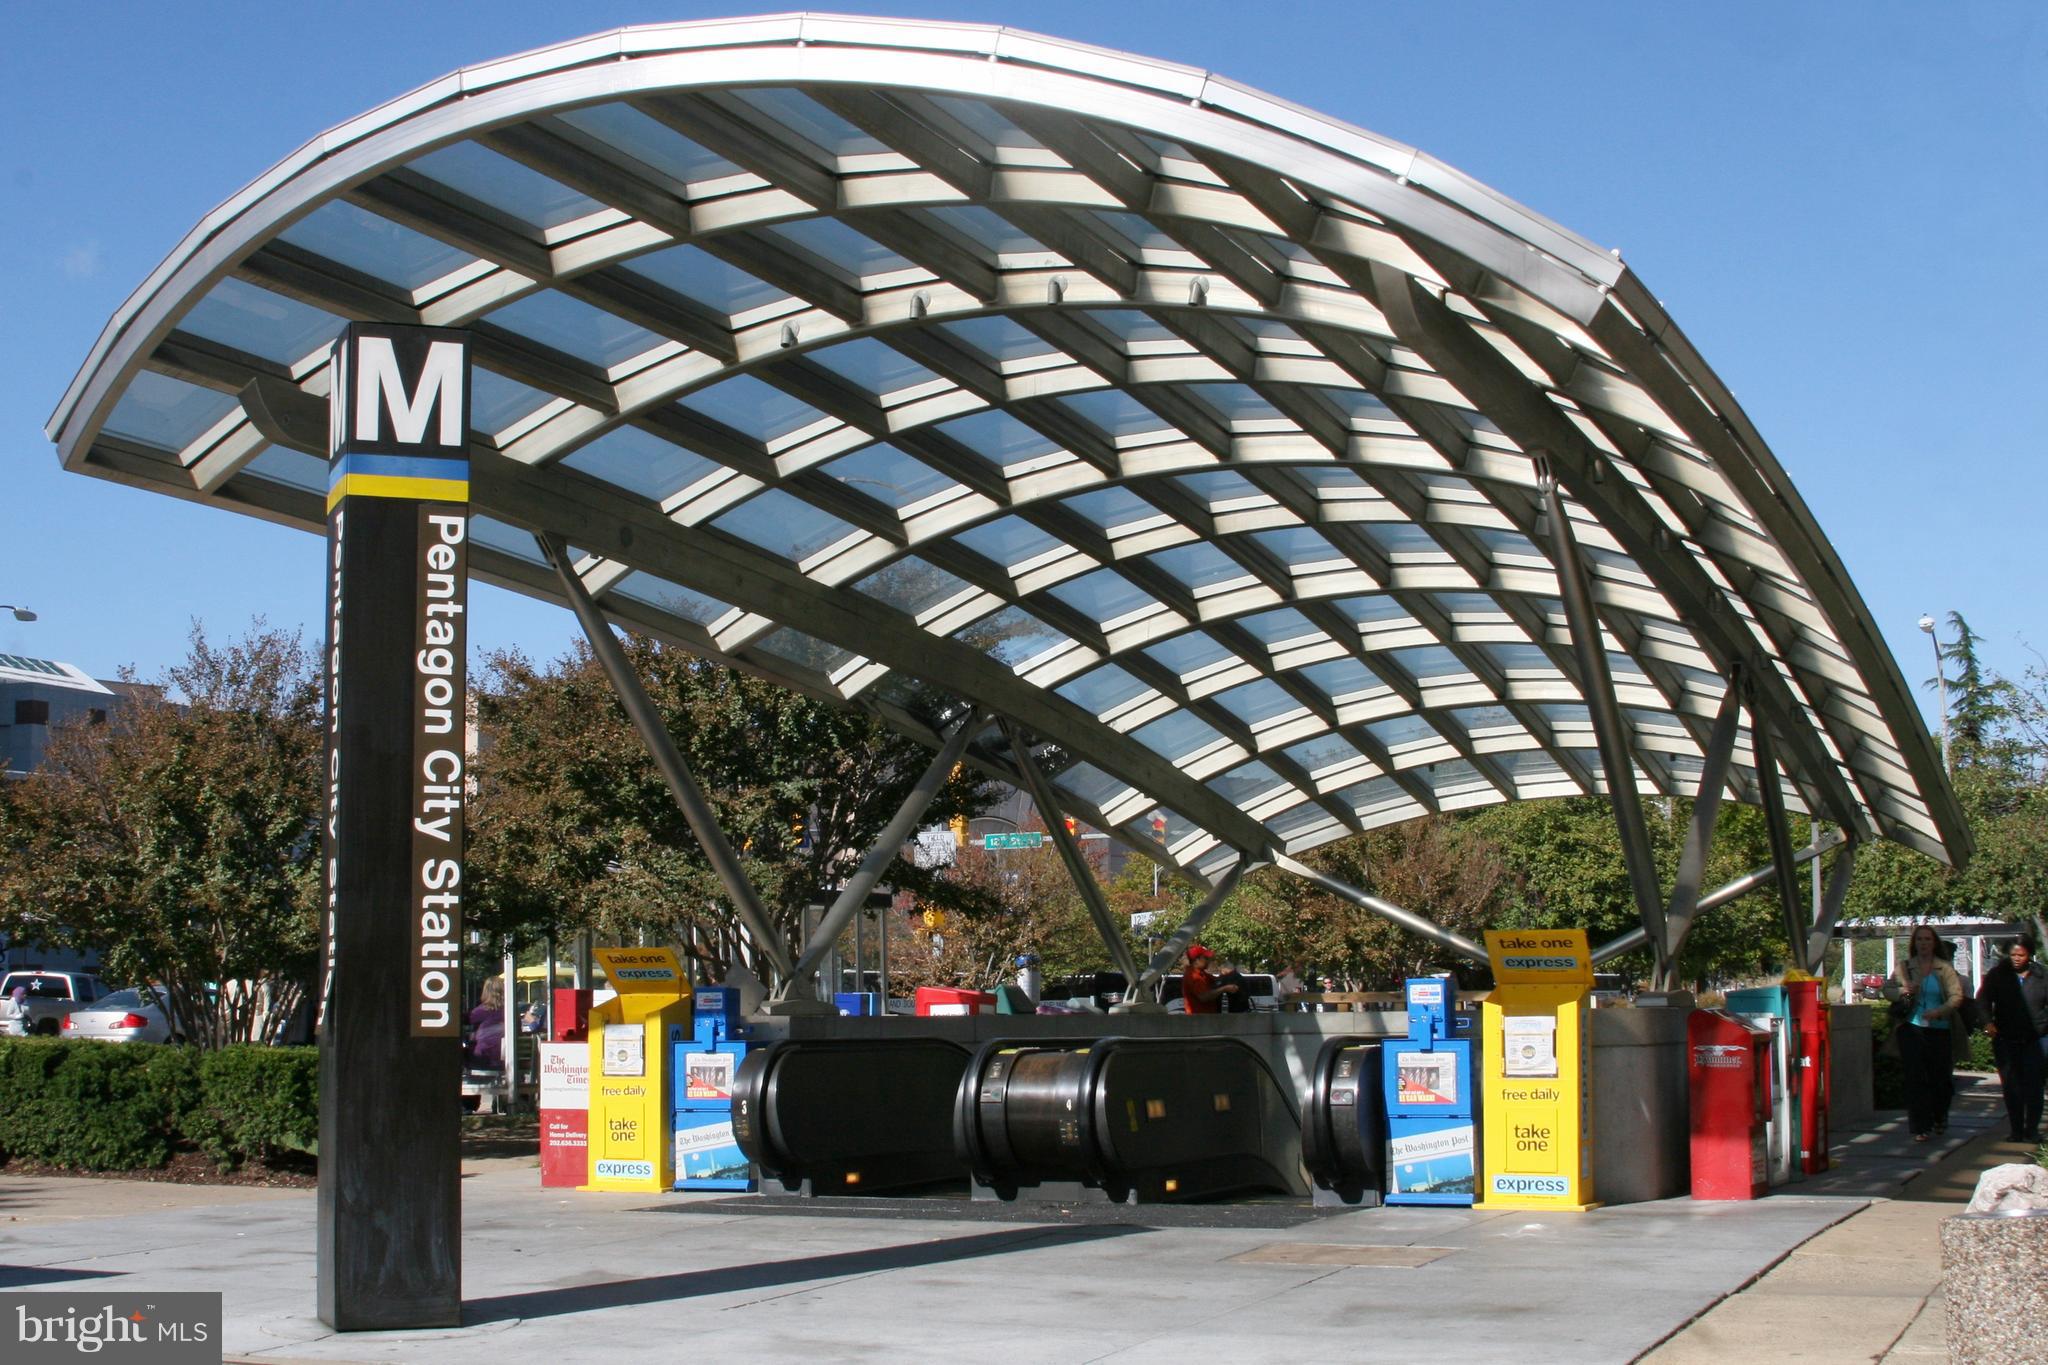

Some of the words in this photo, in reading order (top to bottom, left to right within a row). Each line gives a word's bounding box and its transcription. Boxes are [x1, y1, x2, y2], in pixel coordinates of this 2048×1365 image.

[356, 336, 464, 447] M
[329, 338, 348, 461] M
[331, 511, 344, 733] Pentagon
[417, 515, 465, 734] Pentagon
[329, 748, 339, 839] City
[414, 750, 461, 842] City
[420, 859, 460, 1028] Station
[1499, 938, 1537, 949] take
[1541, 940, 1573, 949] one
[607, 953, 637, 964] take
[640, 955, 666, 963] one
[1505, 958, 1574, 968] express
[618, 969, 673, 979] express
[550, 1054, 565, 1064] The
[544, 1064, 589, 1076] Washingto
[567, 1075, 589, 1084] Time
[601, 1085, 621, 1096] free
[623, 1085, 646, 1097] daily
[1502, 1088, 1528, 1100] free
[1530, 1088, 1559, 1102] daily
[741, 1100, 747, 1115] 3
[1066, 1099, 1072, 1111] 4
[609, 1118, 637, 1130] take
[611, 1131, 636, 1141] one
[679, 1136, 691, 1146] The
[692, 1130, 730, 1142] Washington
[1514, 1124, 1551, 1139] take
[1390, 1146, 1403, 1155] The
[1405, 1139, 1450, 1153] Washington
[1451, 1135, 1469, 1147] Post
[1516, 1140, 1548, 1151] one
[598, 1162, 651, 1176] express
[1496, 1178, 1565, 1193] express
